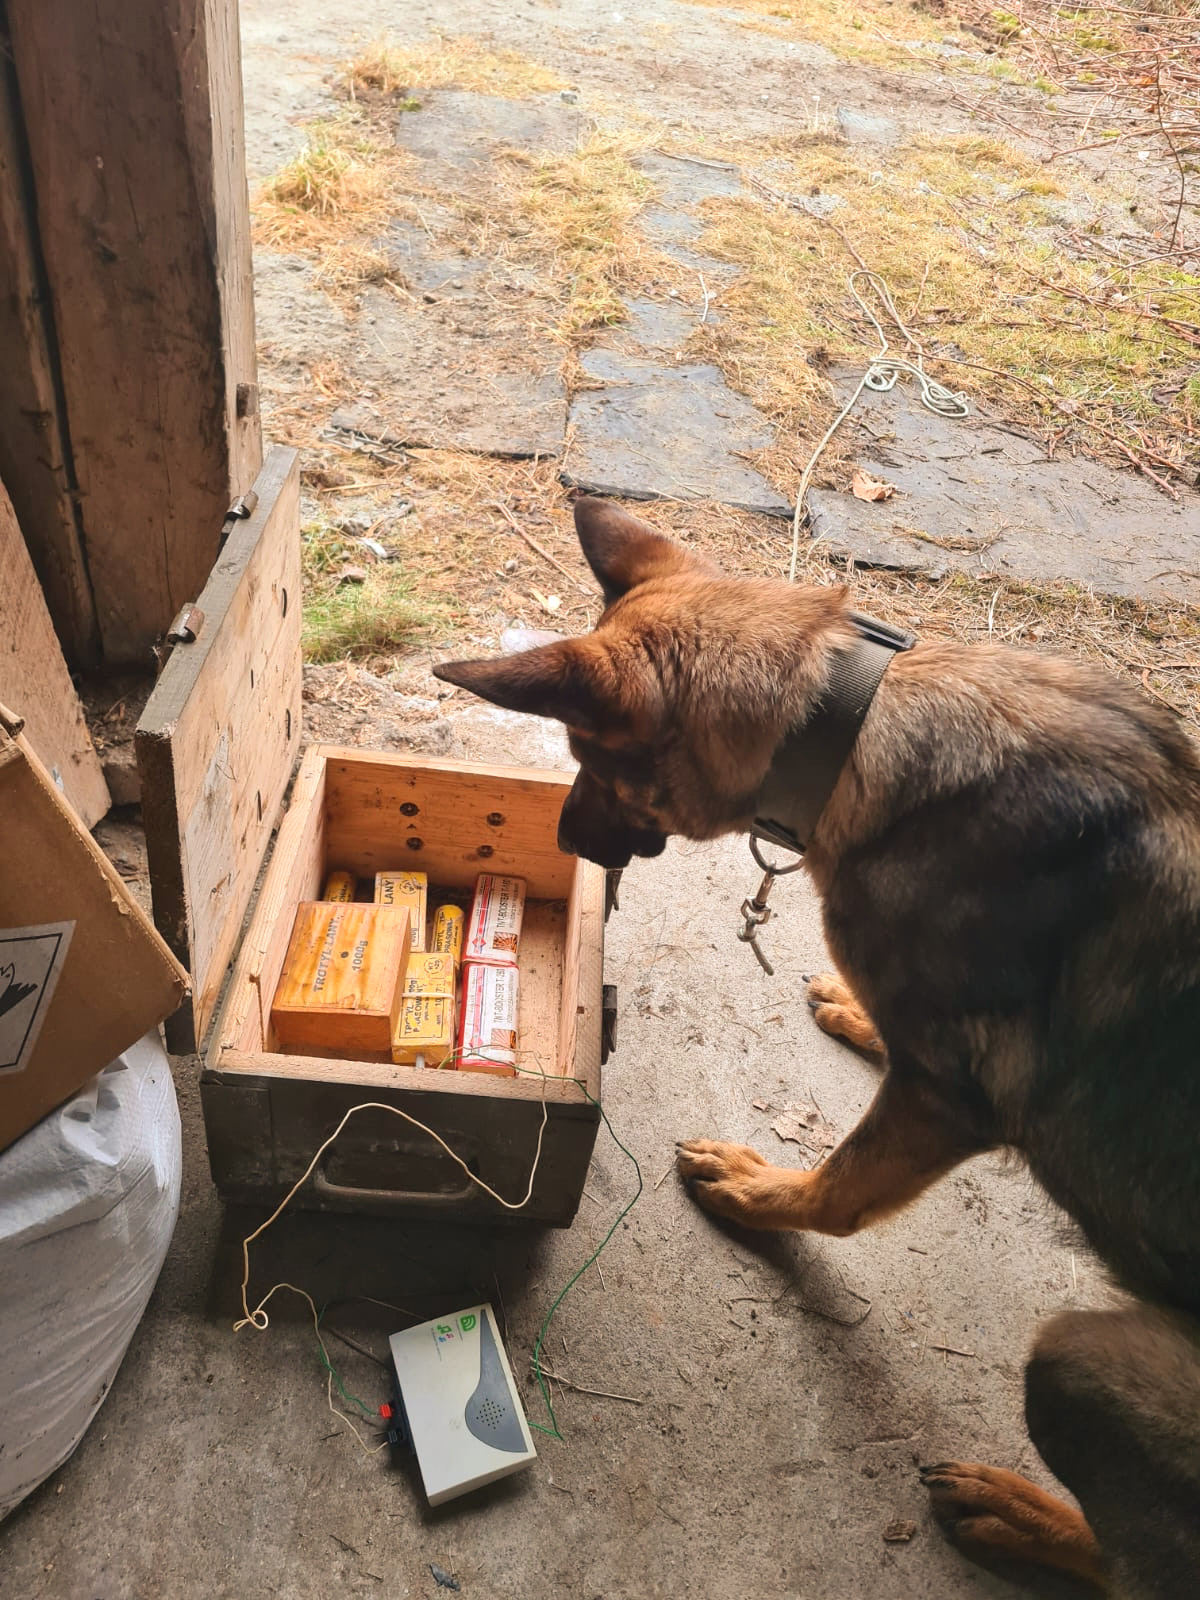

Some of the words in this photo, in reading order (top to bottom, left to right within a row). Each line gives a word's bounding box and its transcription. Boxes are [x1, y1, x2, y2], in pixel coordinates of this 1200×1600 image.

[384, 880, 394, 905] LANY
[312, 949, 331, 992] TROTYL
[351, 940, 368, 971] 1000g
